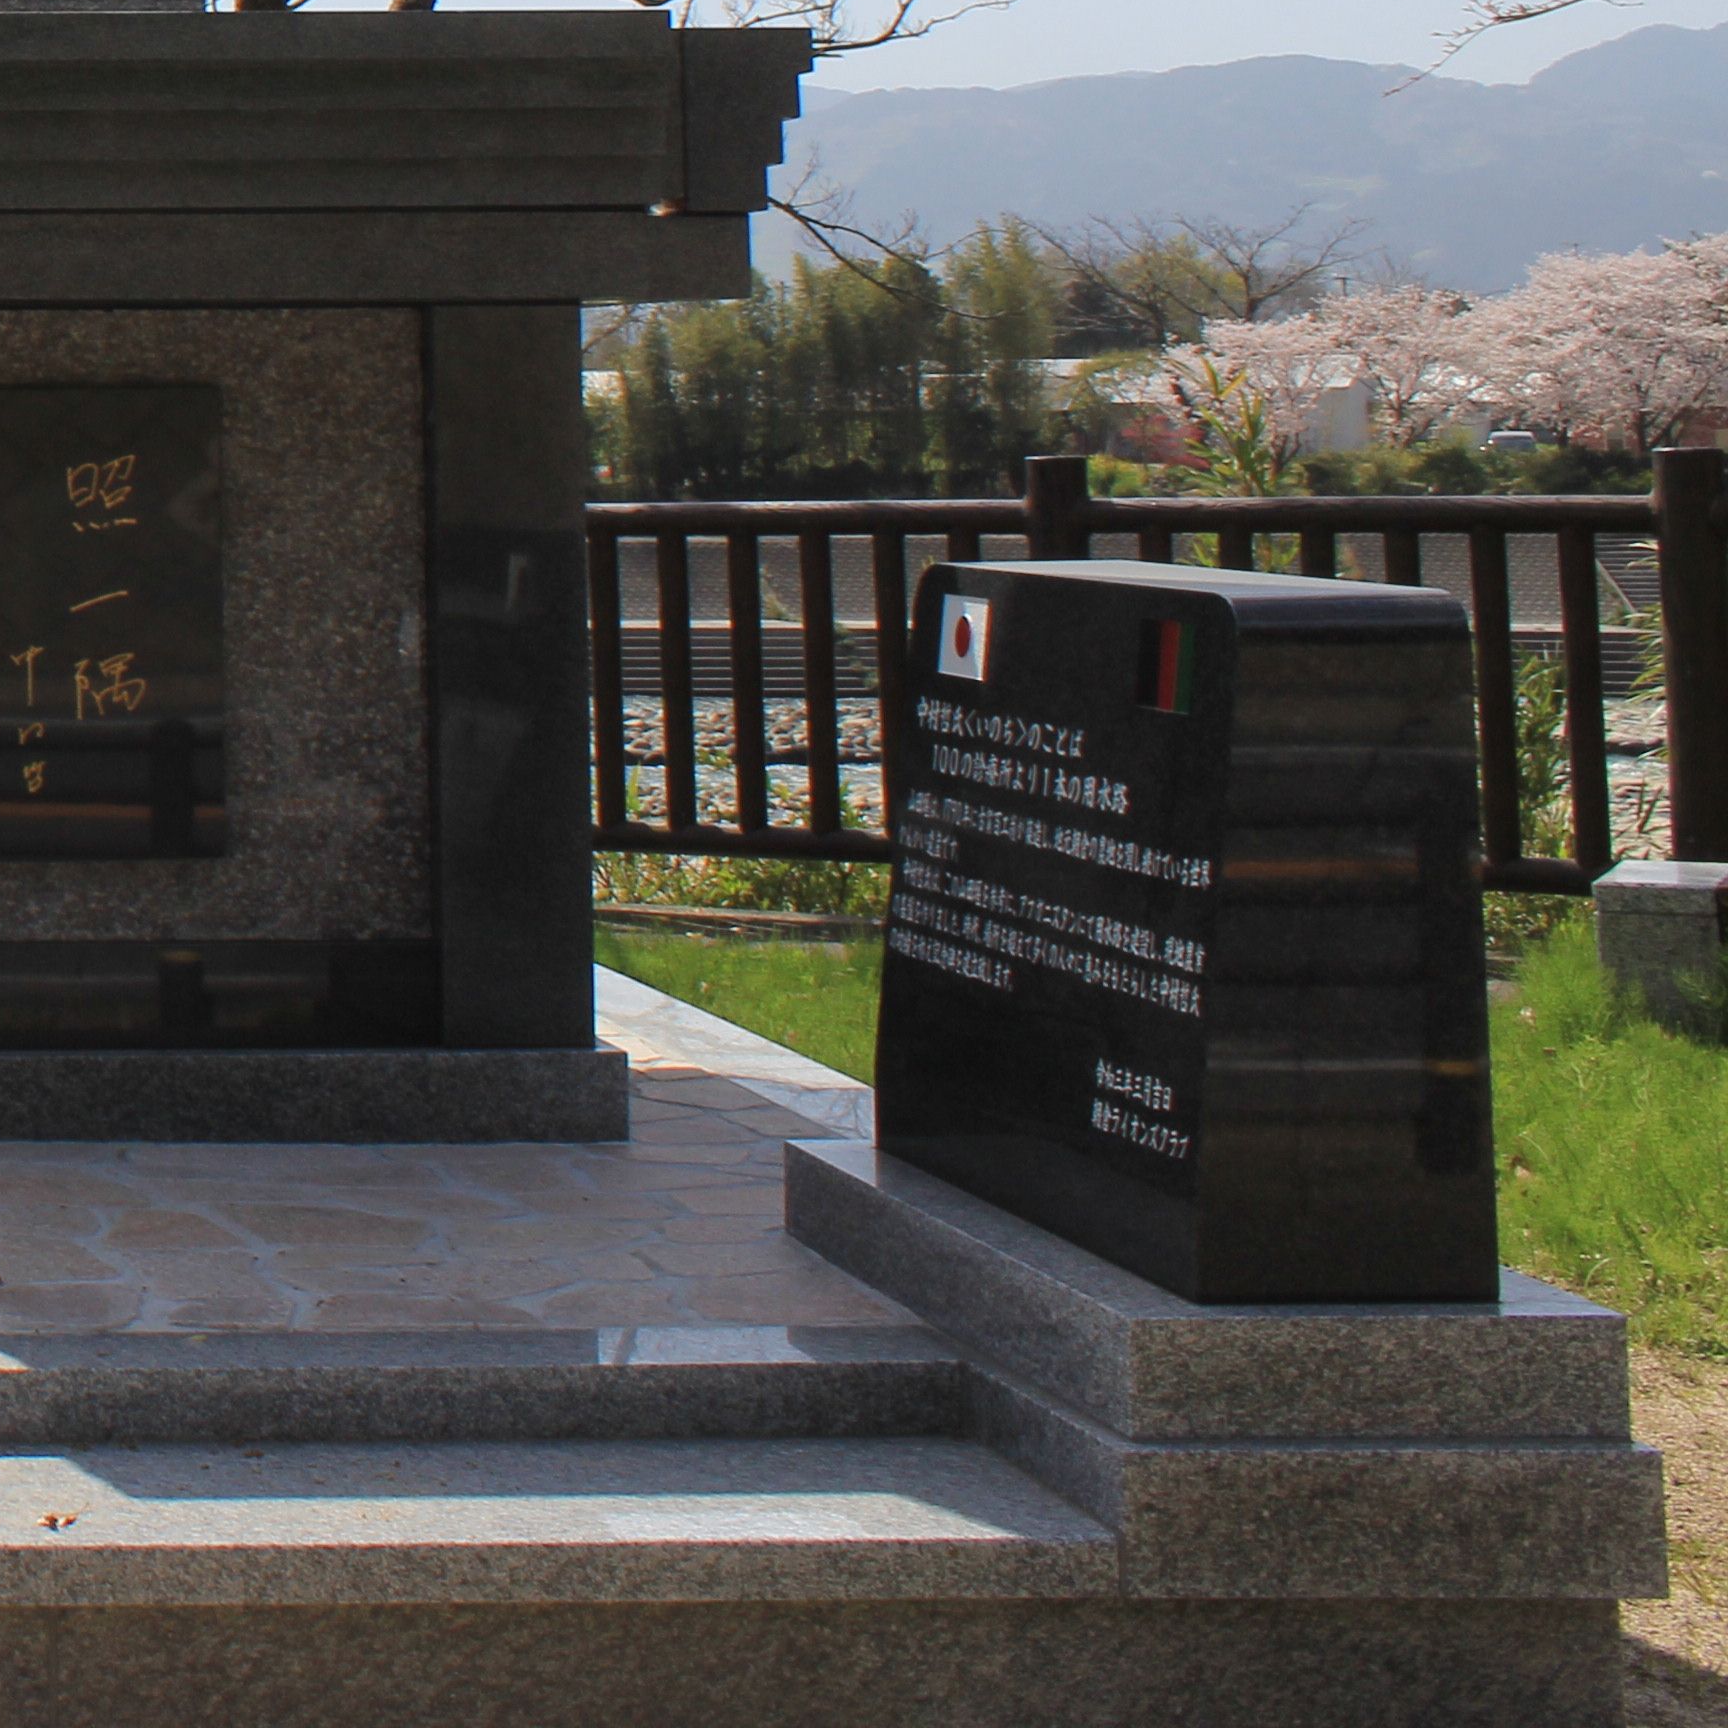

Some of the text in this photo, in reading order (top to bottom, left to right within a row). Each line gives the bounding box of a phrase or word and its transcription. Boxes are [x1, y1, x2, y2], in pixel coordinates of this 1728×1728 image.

[65, 453, 148, 721] 照一隅
[1096, 1058, 1172, 1112] 令和三年三月吉日
[1091, 1102, 1190, 1161] 朝倉ライオンズクラブ
